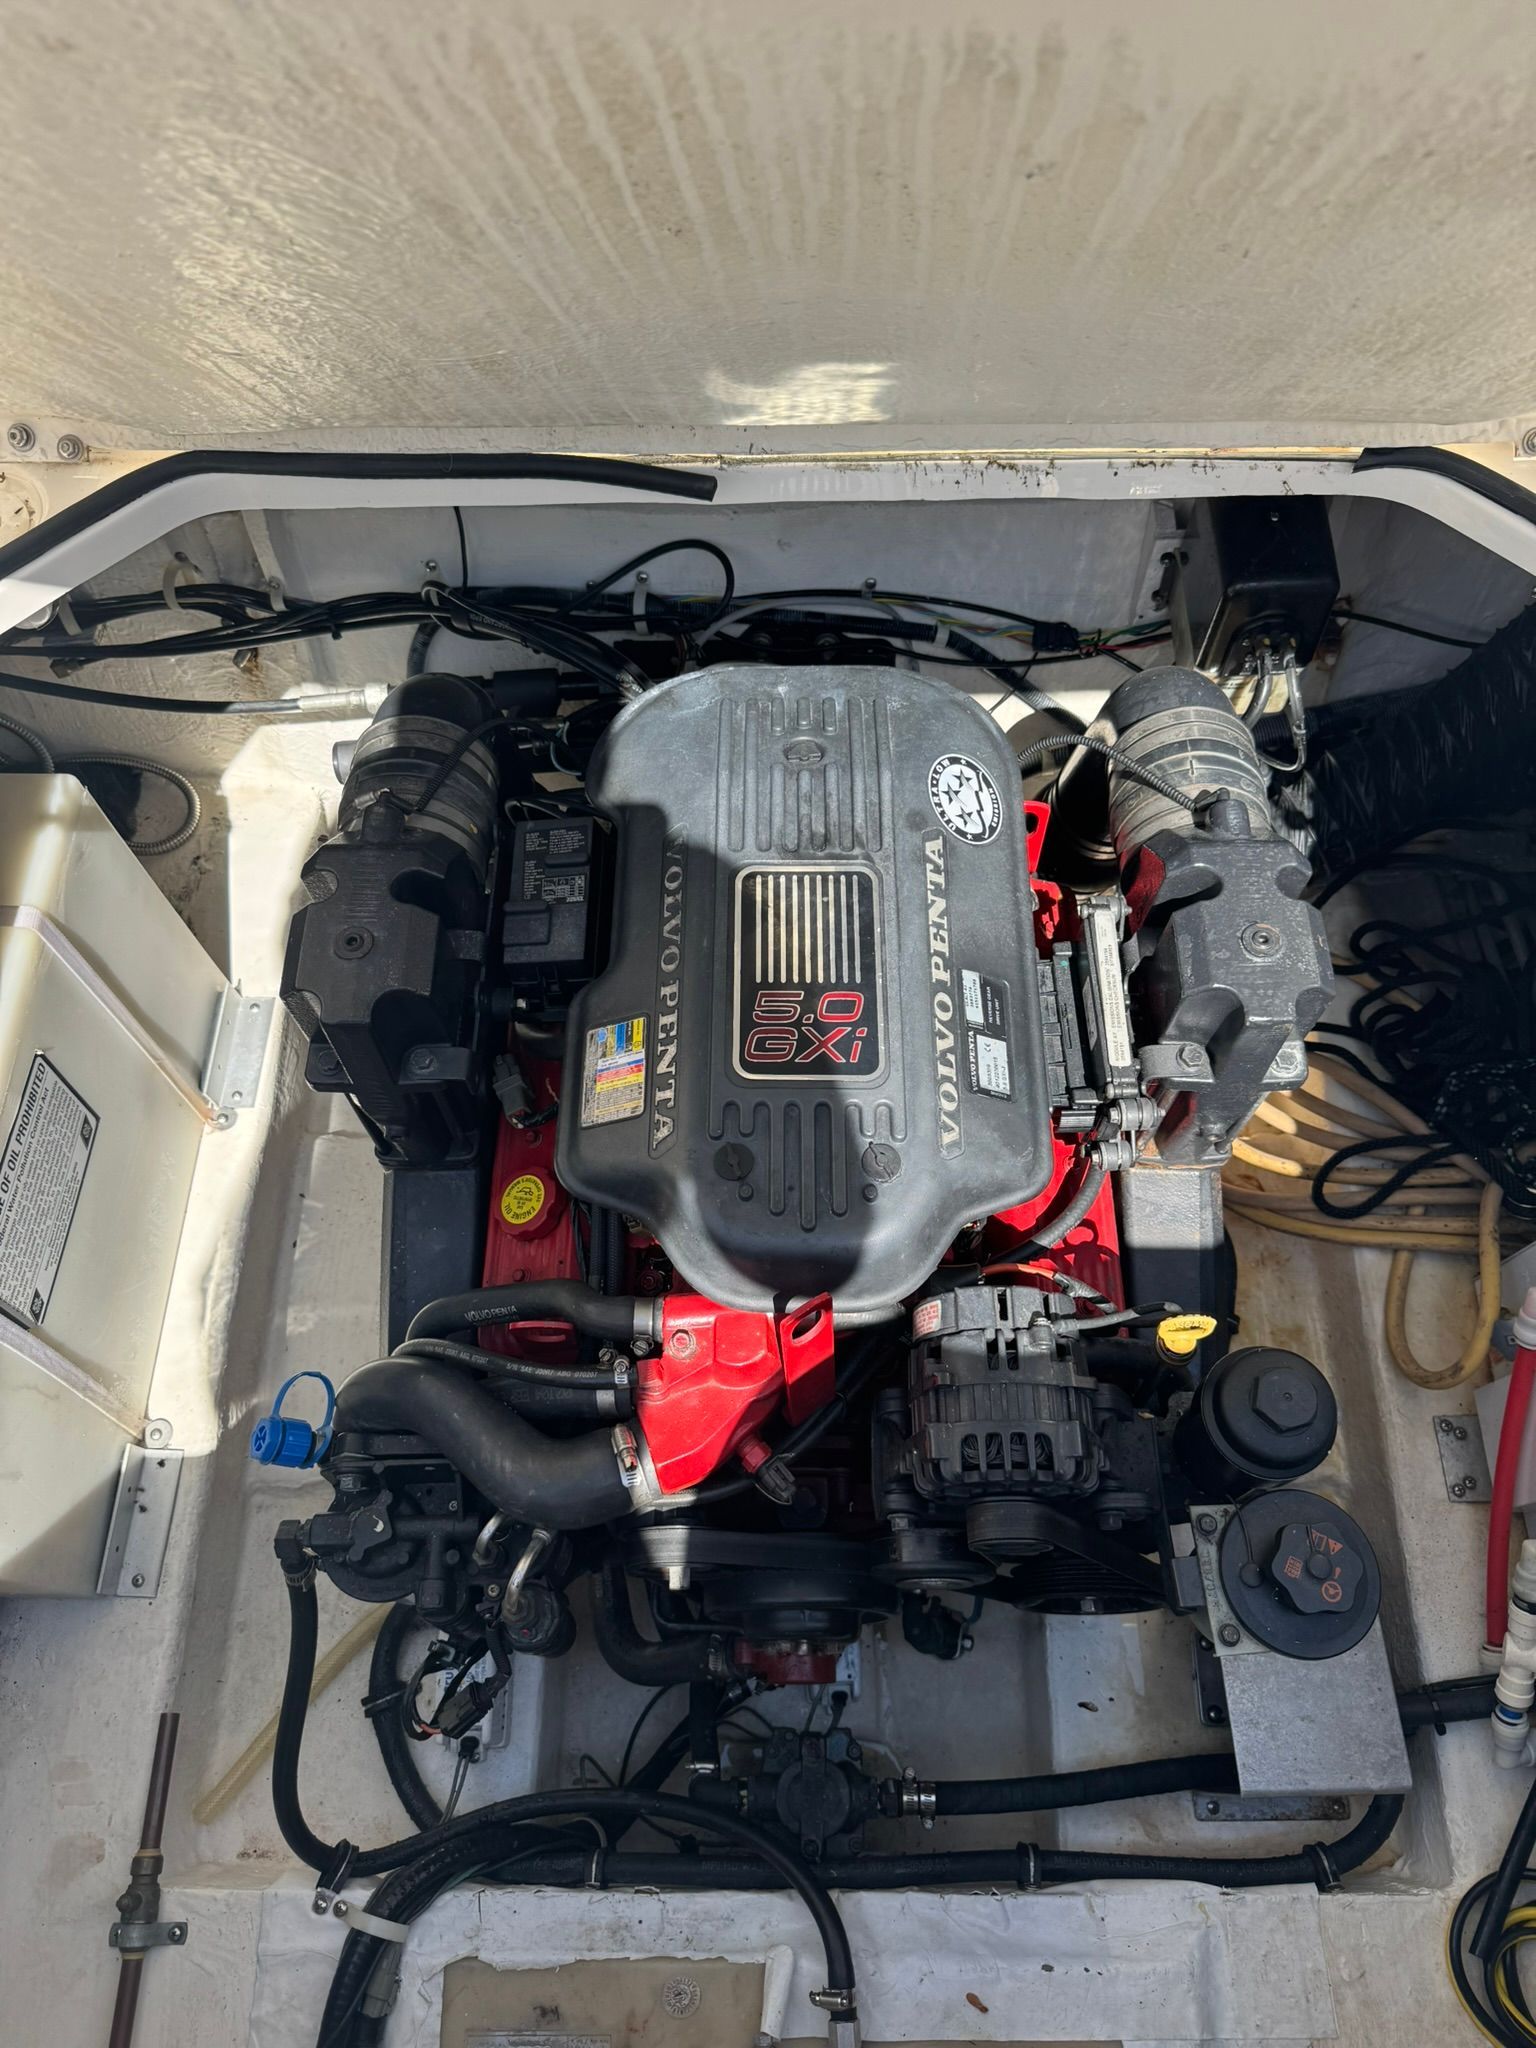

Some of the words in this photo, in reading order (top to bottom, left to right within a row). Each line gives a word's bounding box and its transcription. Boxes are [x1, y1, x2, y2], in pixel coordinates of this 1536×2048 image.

[660, 836, 685, 972] VOLVO
[927, 837, 952, 987] PENTA
[752, 990, 865, 1024] 5.0
[744, 1026, 867, 1064] GXi
[967, 1030, 976, 1063] PENTA
[652, 979, 680, 1150] PENTA
[934, 992, 961, 1152] VOLVO
[969, 1064, 978, 1091] VOLVO
[0, 1170, 12, 1194] OF
[6, 1144, 20, 1172] OIL
[14, 1060, 46, 1146] PROHIBITED
[7, 1183, 19, 1213] Water
[16, 1139, 32, 1182] Pollution
[29, 1103, 43, 1140] Control
[40, 1085, 48, 1104] Act
[503, 1202, 512, 1214] OIL
[510, 1206, 536, 1219] ENGINE
[464, 1308, 491, 1323] VOLVO
[491, 1305, 517, 1317] PENTA
